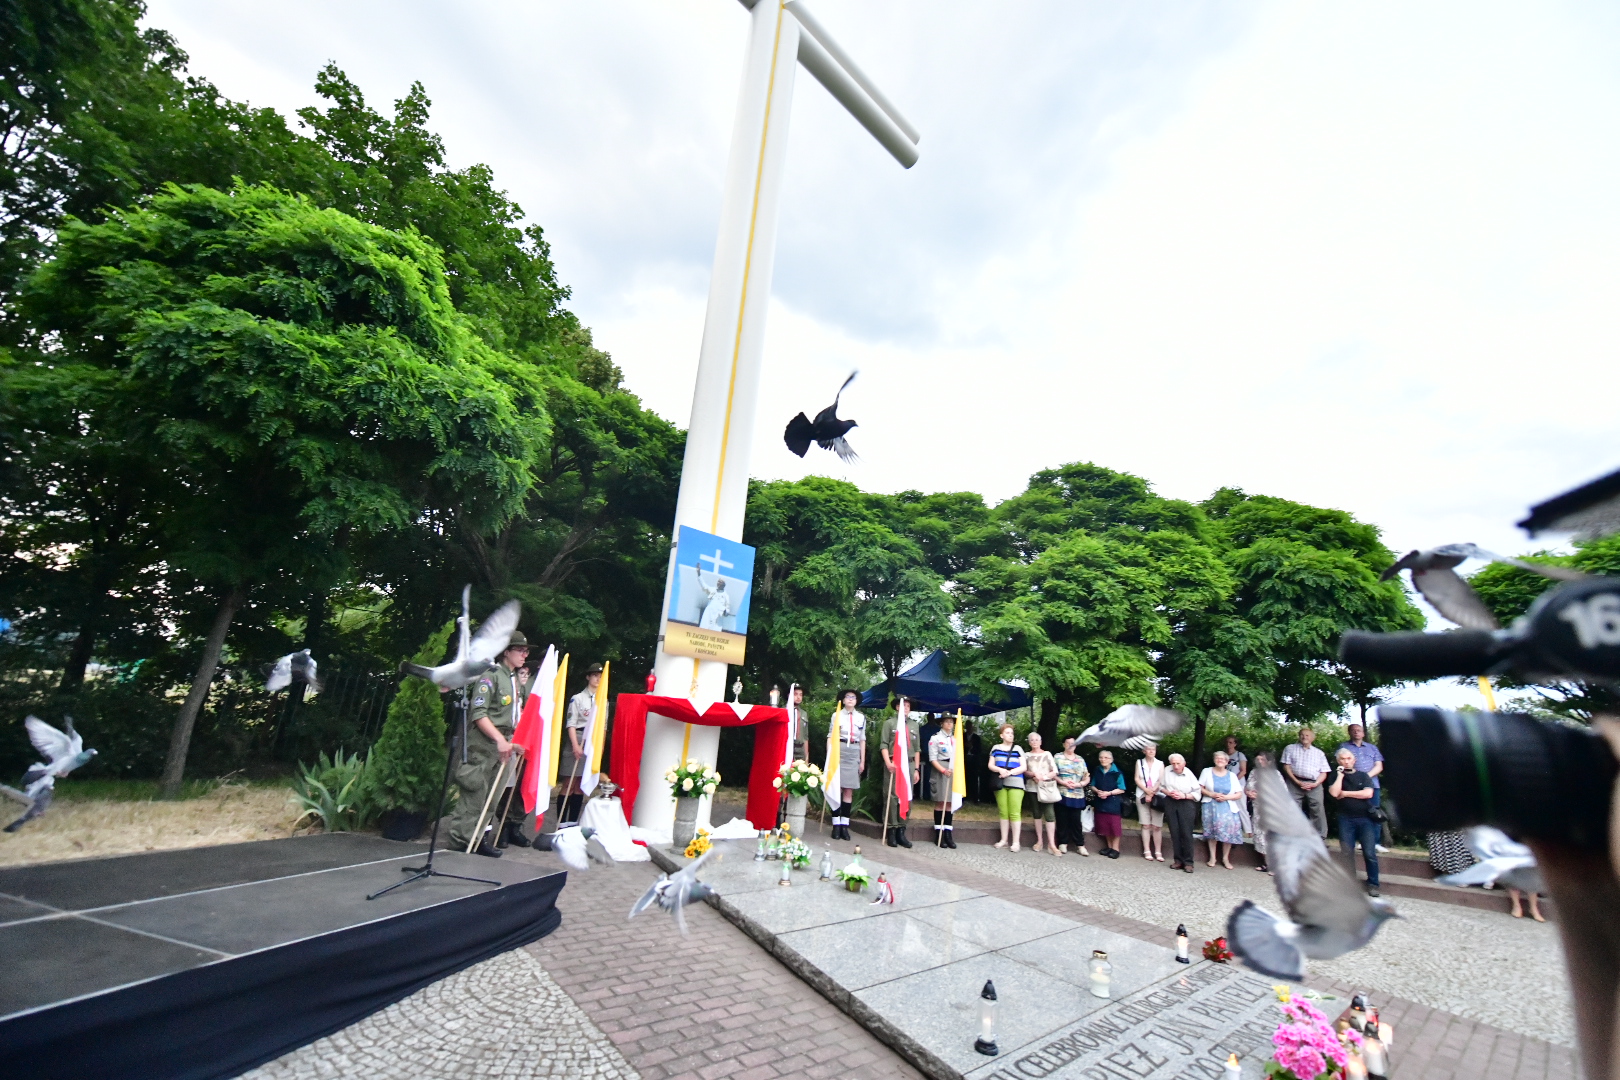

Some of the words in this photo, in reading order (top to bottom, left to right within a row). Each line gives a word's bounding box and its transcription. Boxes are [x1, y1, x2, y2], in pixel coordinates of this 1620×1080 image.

[1013, 1014, 1131, 1079] CELEBROWAŁ
[1141, 1013, 1218, 1056] JAN
[1188, 981, 1268, 1023] PAWEŁ
[1239, 975, 1275, 991] II
[1187, 1058, 1226, 1080] 20
